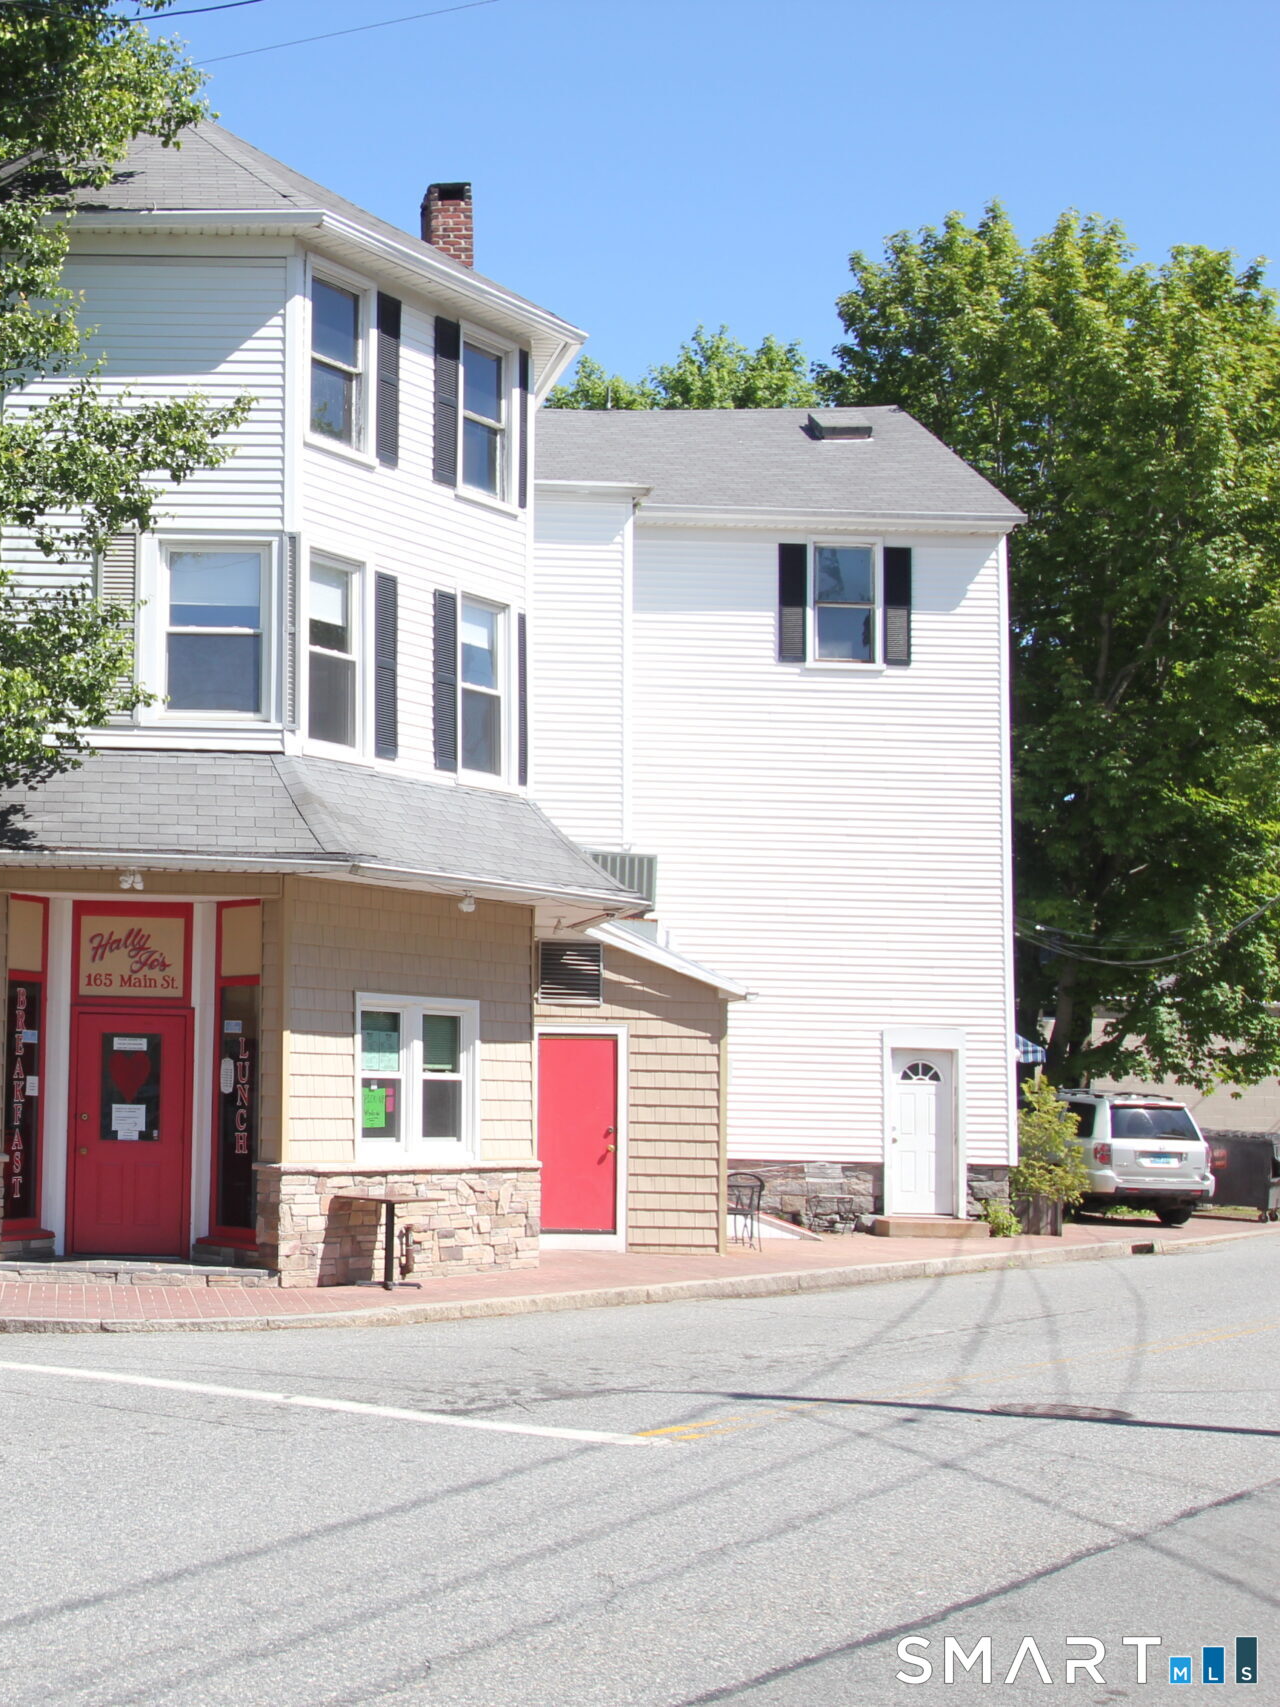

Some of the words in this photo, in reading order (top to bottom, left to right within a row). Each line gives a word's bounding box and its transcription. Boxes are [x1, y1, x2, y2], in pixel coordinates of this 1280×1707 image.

[89, 928, 151, 963] Hally
[130, 950, 172, 974] Jo's
[85, 973, 113, 987] 165
[120, 974, 157, 988] Main
[161, 975, 178, 989] St.
[12, 987, 27, 1198] BREAKFAST
[234, 1037, 250, 1154] LUNCH
